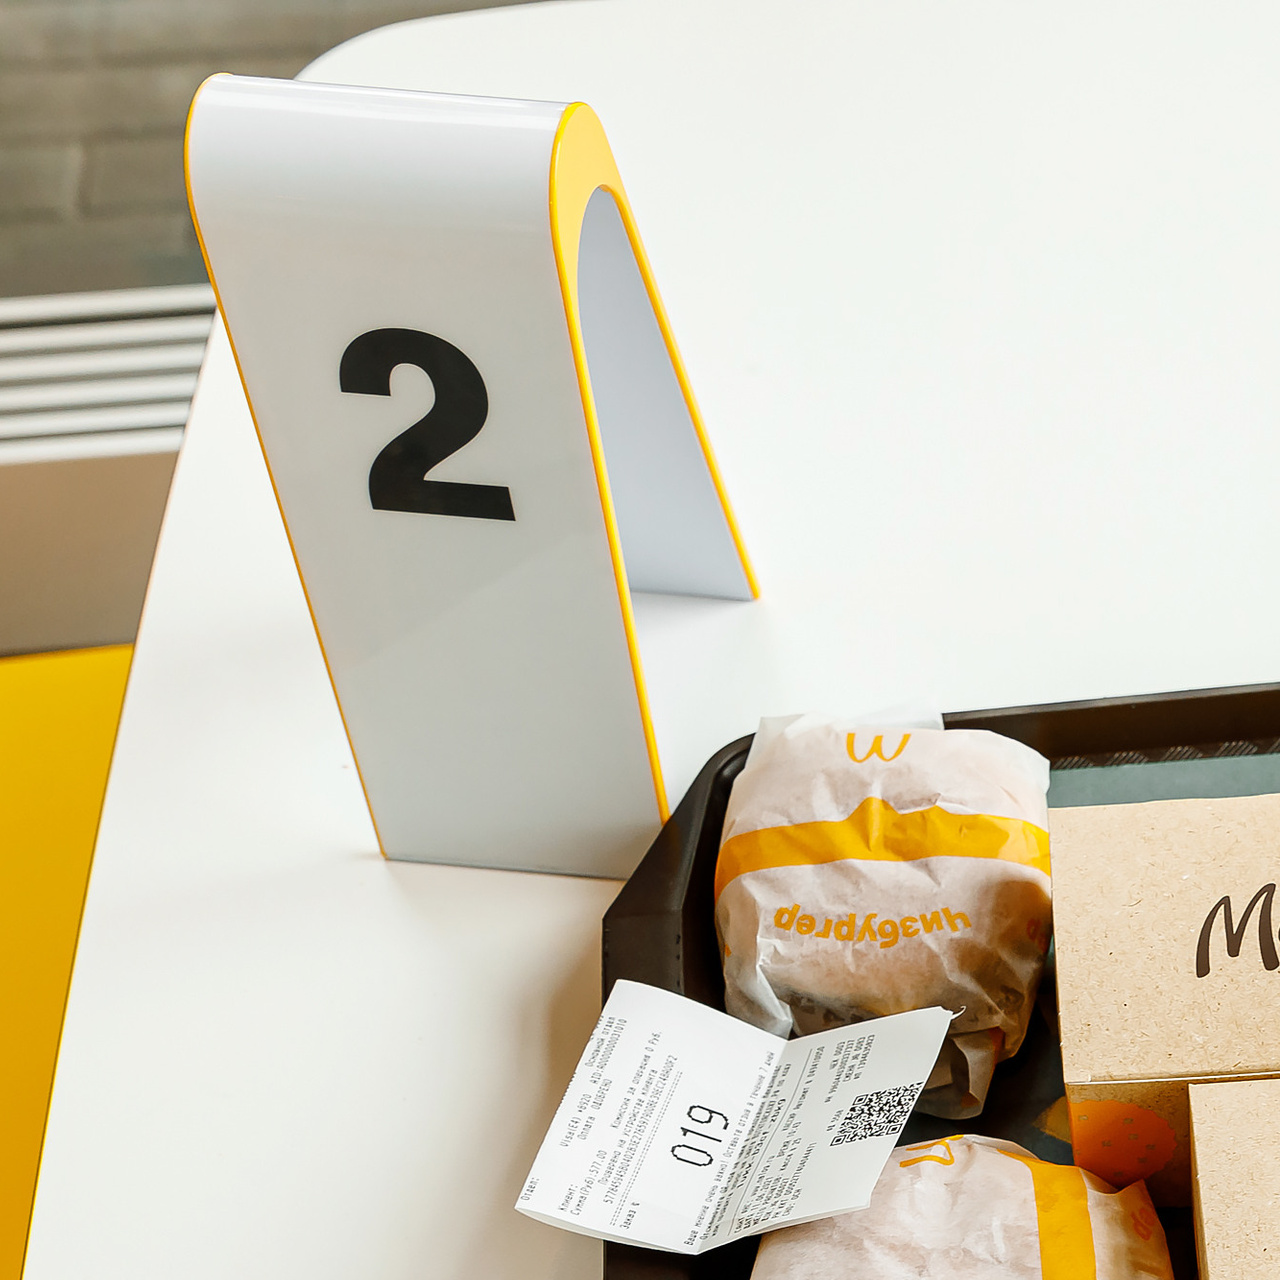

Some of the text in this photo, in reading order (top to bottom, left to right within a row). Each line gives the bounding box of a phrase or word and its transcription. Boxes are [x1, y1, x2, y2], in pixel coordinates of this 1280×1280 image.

[339, 326, 516, 522] 2
[627, 1085, 636, 1095] за
[577, 1115, 596, 1140] Оплата
[598, 1069, 657, 1185] Проверено на устройстве клиента
[668, 1103, 732, 1168] 019
[520, 1176, 539, 1201] Отдел:
[558, 1183, 577, 1211] Клиент:
[620, 1209, 635, 1229] Заказ
[684, 1229, 698, 1245] Ваше
[693, 1204, 709, 1227] мнение
[704, 1183, 718, 1202] очень
